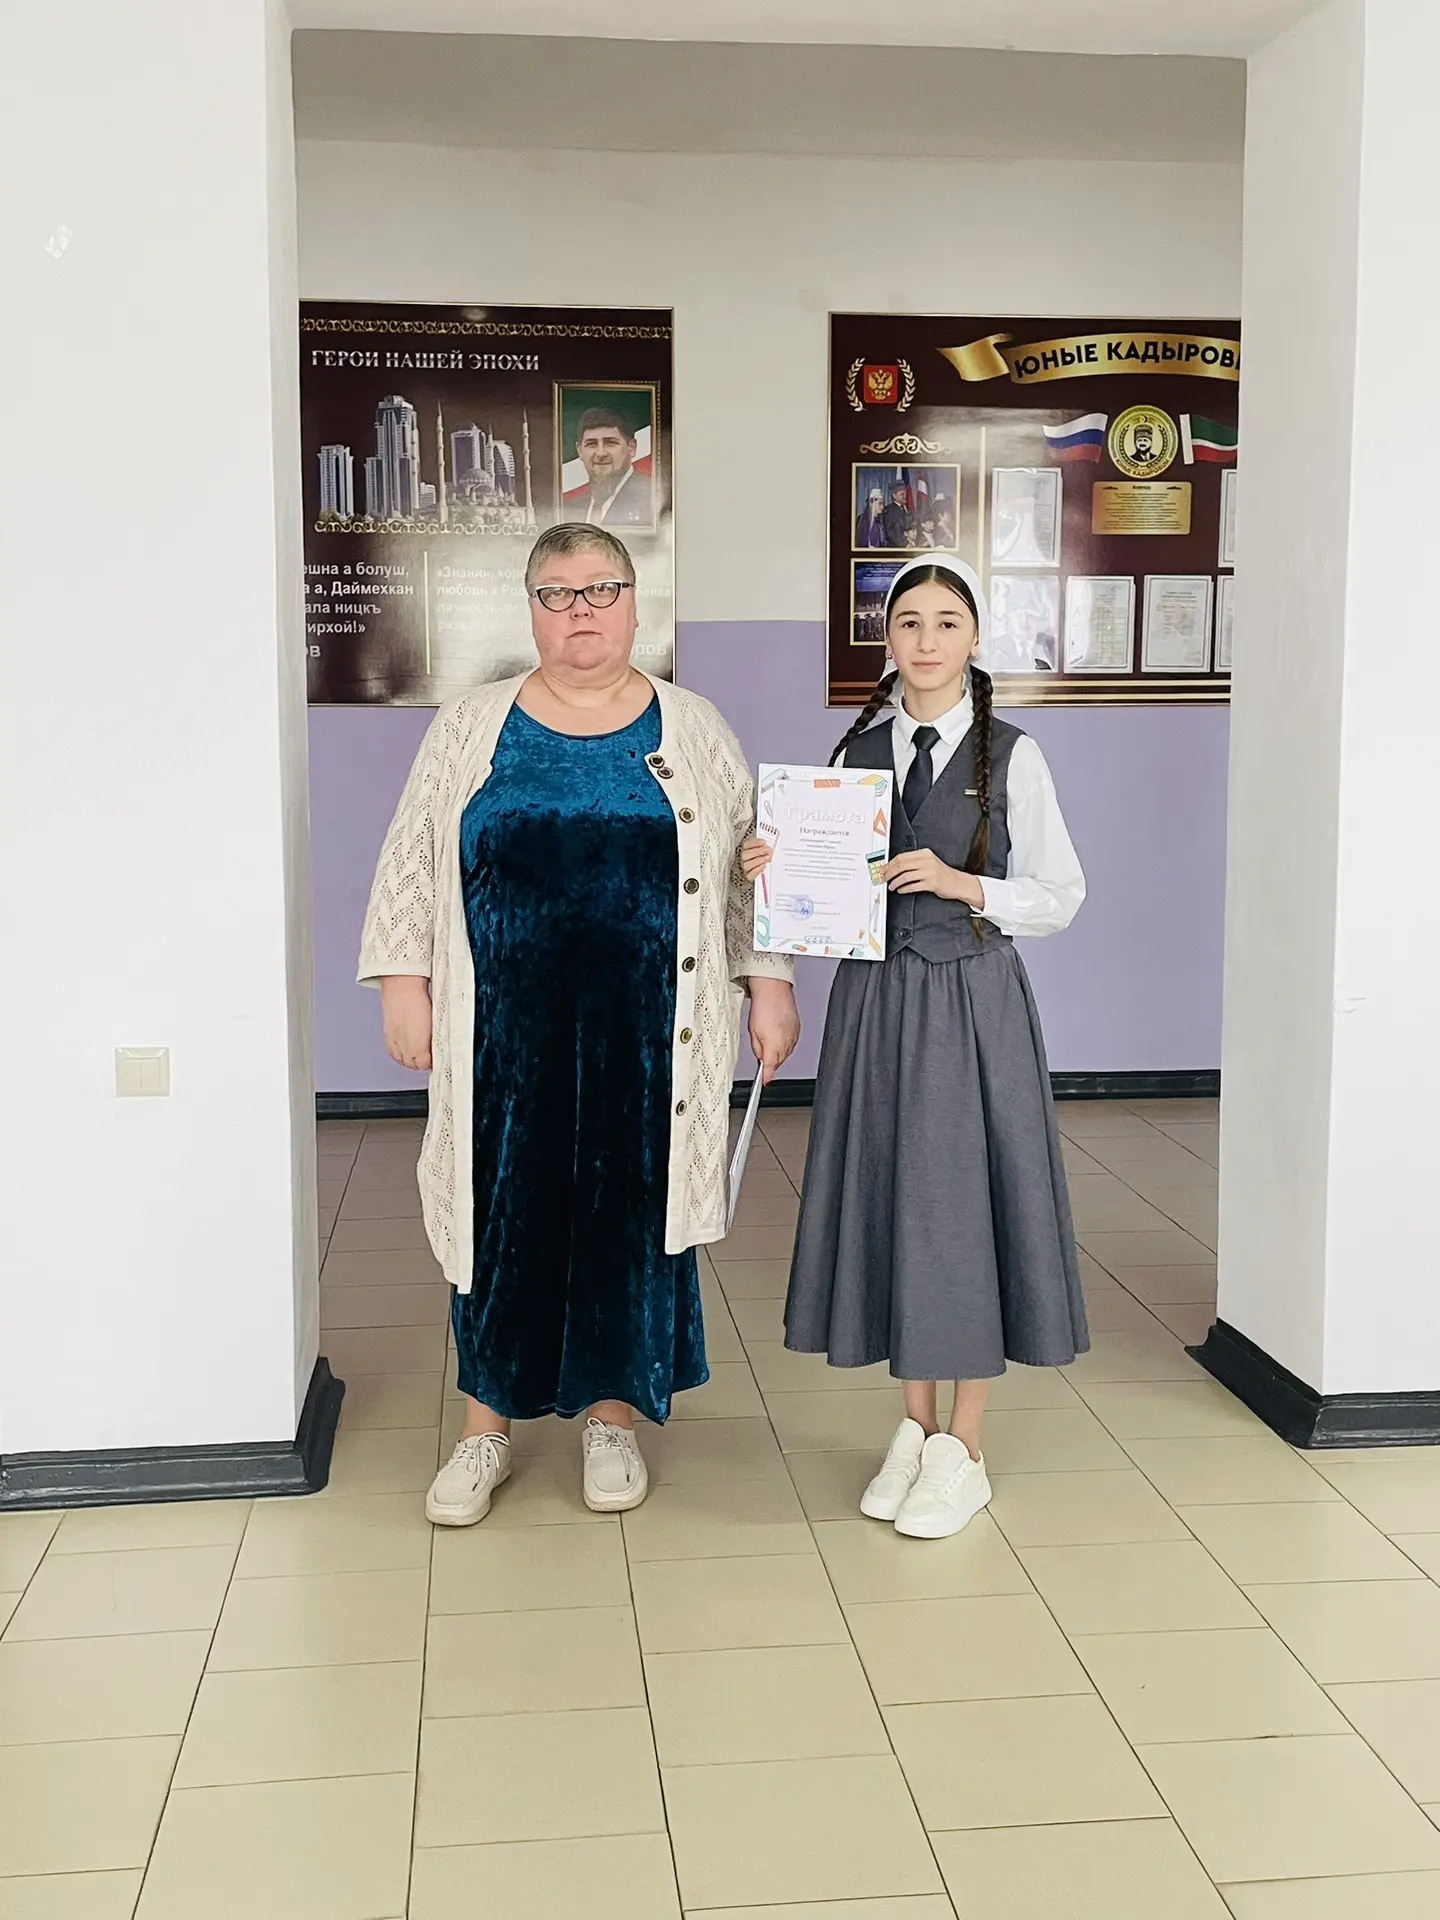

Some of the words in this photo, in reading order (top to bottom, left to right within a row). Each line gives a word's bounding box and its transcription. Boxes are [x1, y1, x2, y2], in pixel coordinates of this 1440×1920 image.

[312, 350, 379, 367] ГЕРОИ
[385, 350, 464, 369] НАШЕЙ
[468, 353, 539, 370] ЭПОХИ
[1014, 343, 1098, 379] ЮНЫЕ
[343, 564, 352, 575] а
[356, 562, 409, 578] болуш,
[314, 583, 327, 596] а,
[331, 581, 414, 596] Даймехкан
[335, 603, 382, 616] ницкъ
[786, 805, 866, 824] Грамота
